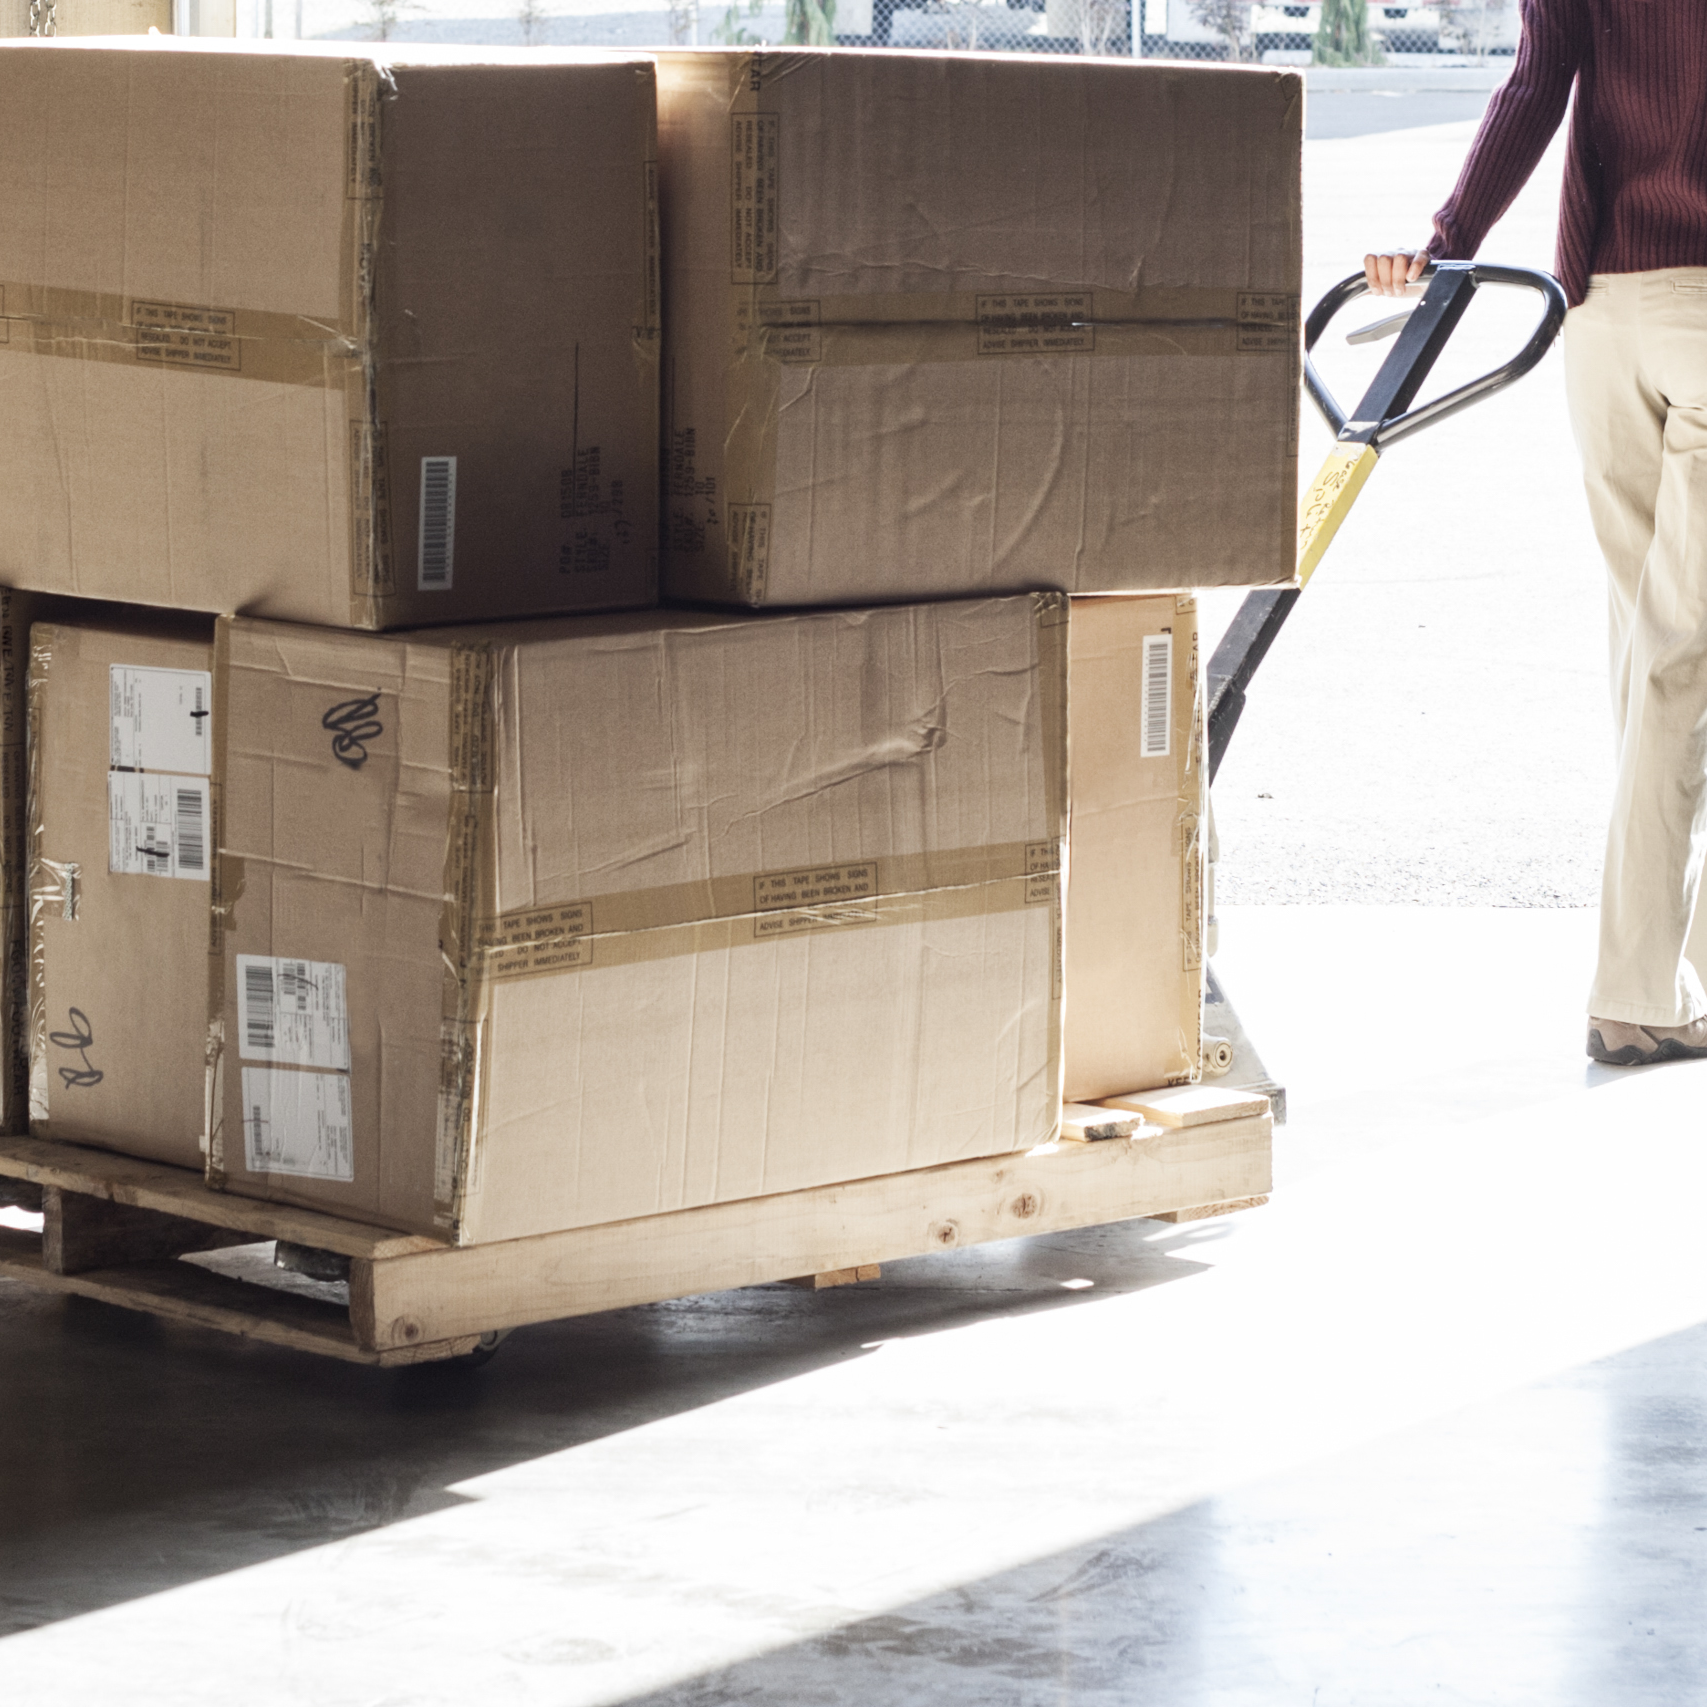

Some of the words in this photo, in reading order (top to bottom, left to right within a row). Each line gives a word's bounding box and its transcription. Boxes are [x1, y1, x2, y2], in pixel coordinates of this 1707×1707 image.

[673, 430, 684, 496] FERNDALE
[759, 881, 765, 890] IF
[771, 878, 786, 888] THIS
[794, 876, 810, 885] TAPE
[815, 872, 840, 882] SHOWS
[847, 869, 868, 879] SIGNS
[759, 895, 771, 904] OF
[771, 892, 797, 902] HAVING
[801, 889, 820, 899] BEEN
[823, 885, 851, 895] BROKEN
[854, 883, 868, 892] AND
[503, 919, 520, 929] TAPE
[526, 914, 553, 925] SHOWS
[561, 909, 582, 919] SIGNS
[760, 920, 783, 930] ADVISE
[512, 931, 531, 942] BEEN
[535, 926, 565, 939] BROKEN
[568, 924, 583, 933] AND
[517, 946, 528, 954] DO
[534, 944, 549, 952] NOT
[498, 960, 528, 971] SHIPPER
[534, 952, 580, 966] IMMEDIATELY
